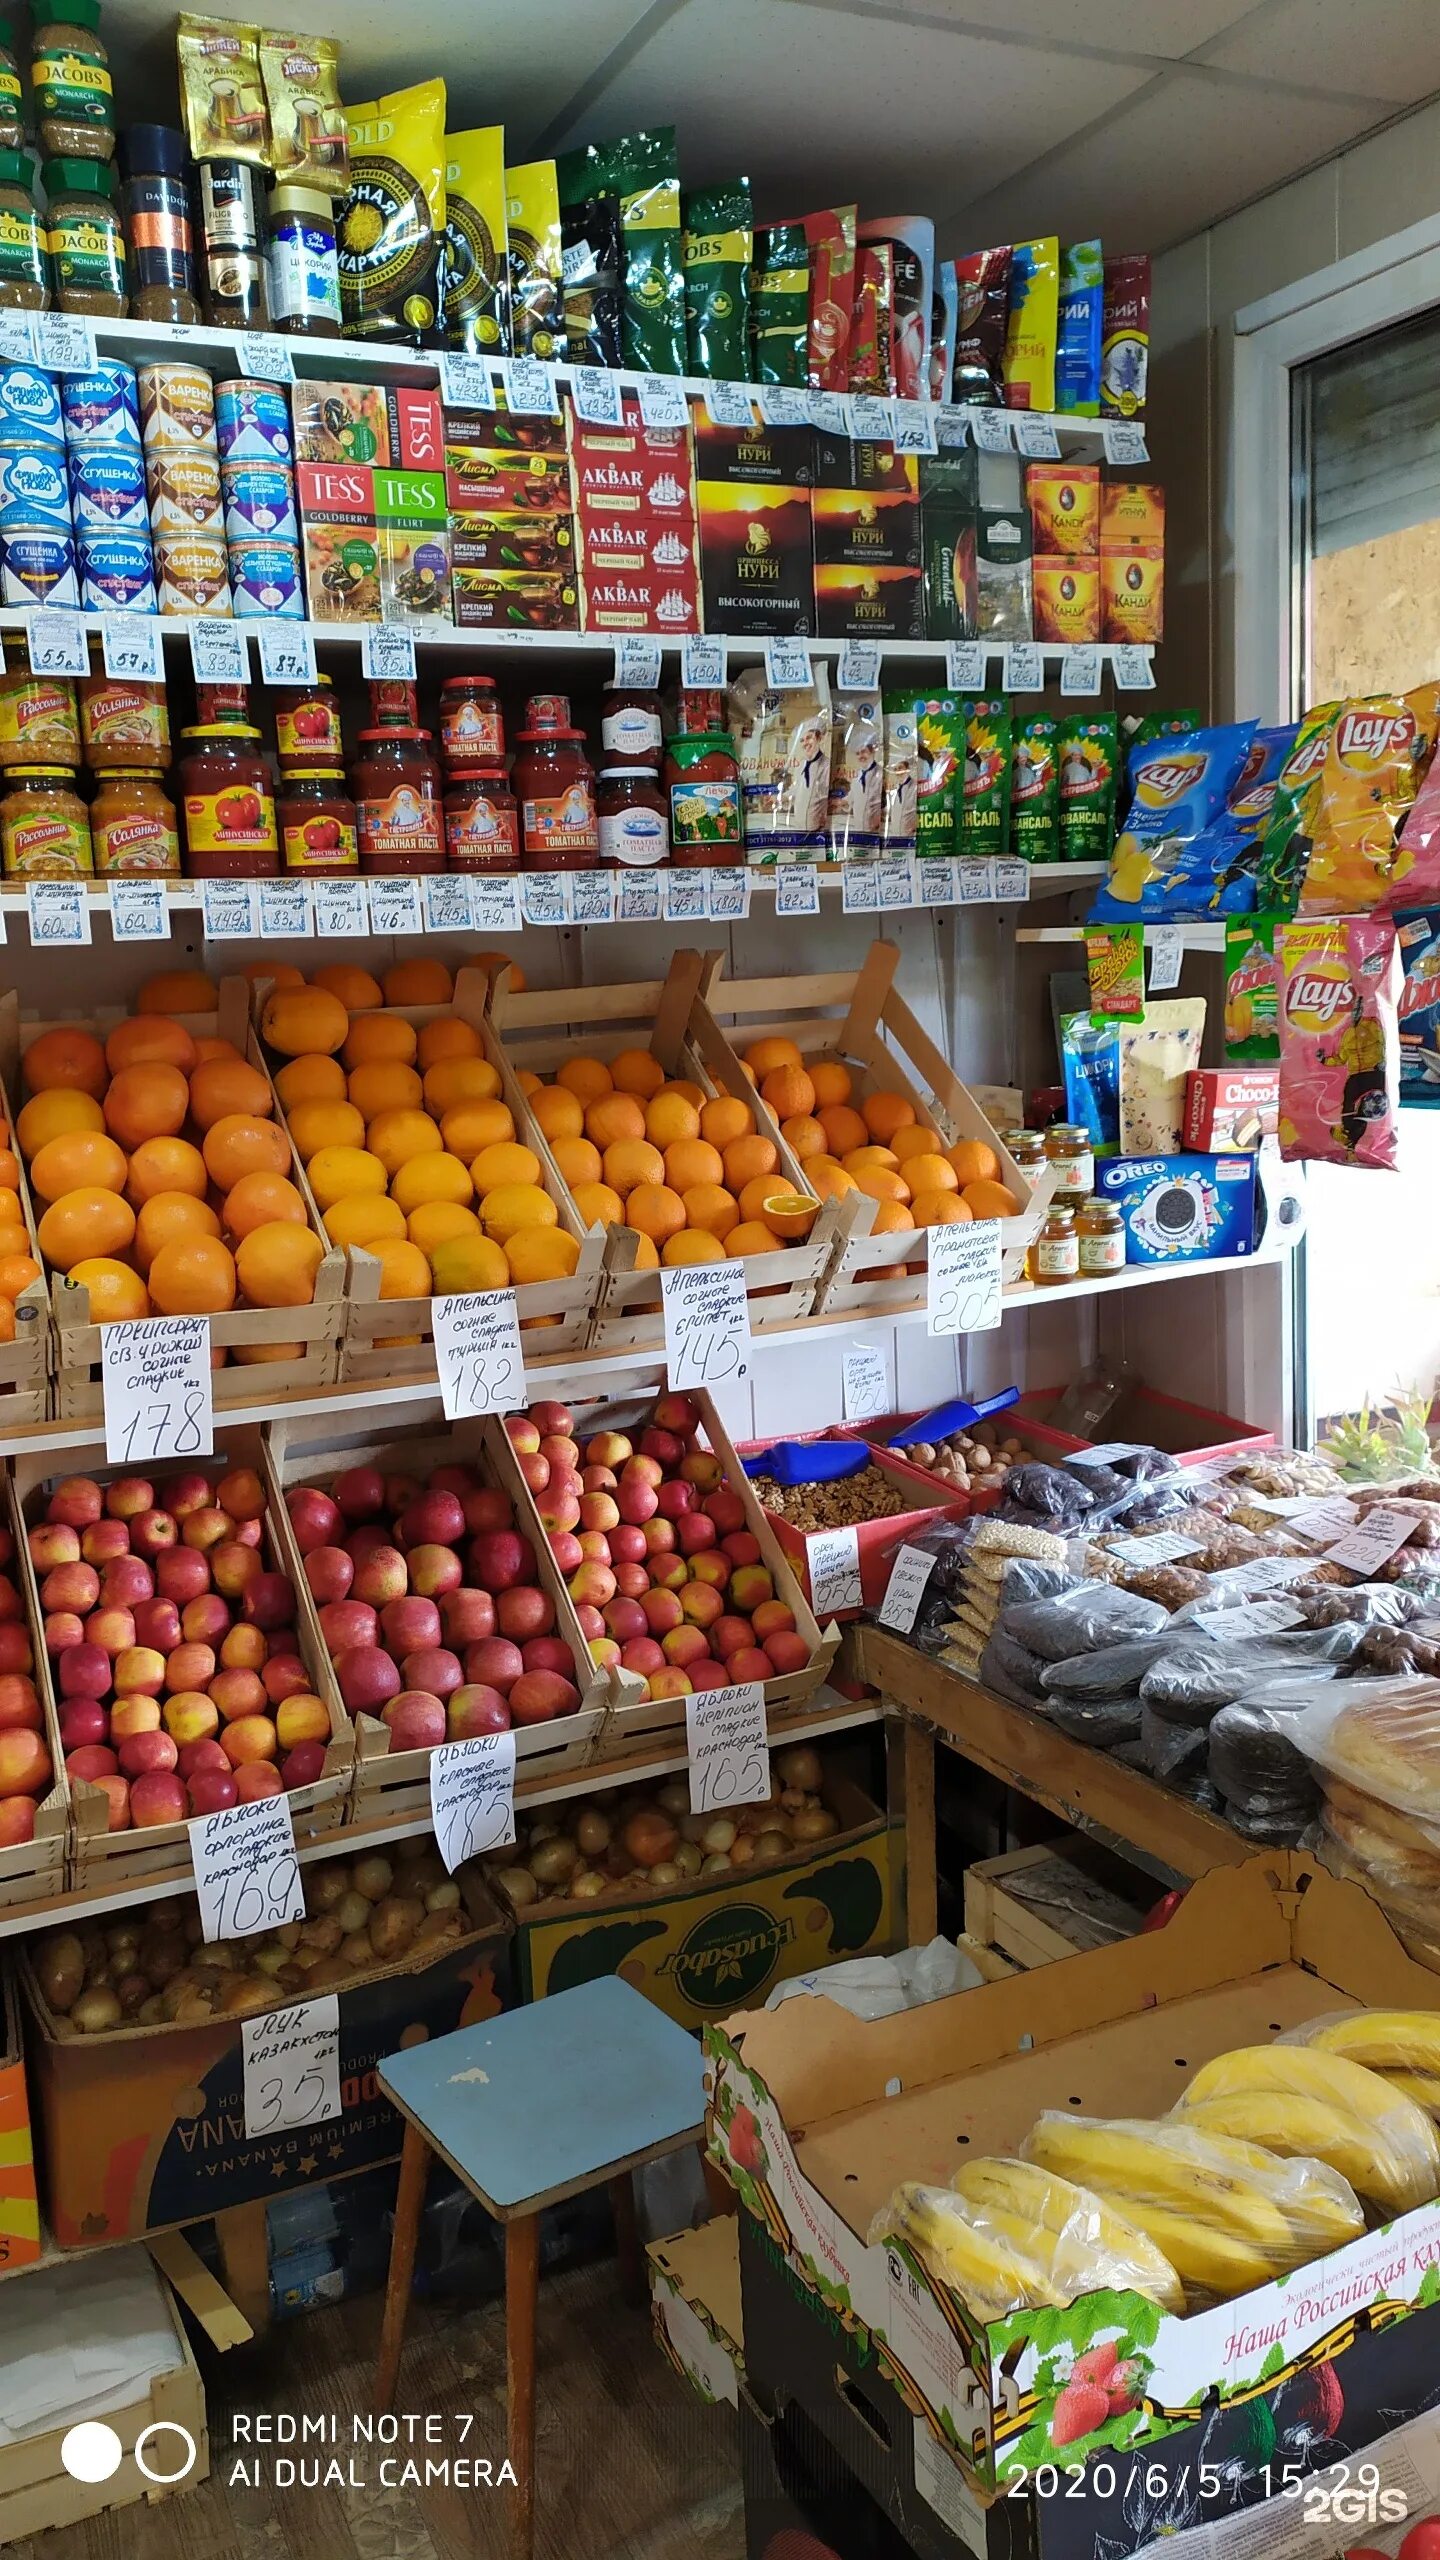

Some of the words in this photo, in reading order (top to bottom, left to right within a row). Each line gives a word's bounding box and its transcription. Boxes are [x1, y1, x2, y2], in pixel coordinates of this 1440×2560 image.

[46, 66, 103, 85] JACOBS
[203, 67, 244, 77] АРАБИКА
[54, 88, 95, 100] MONARCH
[287, 87, 326, 97] ARABICA
[348, 121, 395, 146] OLD
[207, 177, 245, 189] Jardin
[60, 234, 117, 252] JACOBS
[685, 240, 722, 261] OBS
[71, 257, 110, 268] MONARCH
[169, 383, 213, 400] ВАРЕНКА
[387, 395, 400, 460] GOLDBERRY
[407, 401, 436, 460] TESS
[448, 422, 481, 430] КРЕПКИЙ
[900, 429, 924, 447] 152
[737, 449, 772, 462] НУРИ
[83, 468, 138, 482] СГУЩЕНКА
[170, 469, 218, 486] ВАРЕНКА
[582, 468, 643, 487] AKBAR
[309, 473, 365, 504] TESS
[381, 480, 436, 509] TESS
[458, 484, 505, 494] НАСЫЩЕННЫЙ
[309, 511, 369, 525] GOLDBERRY
[397, 519, 424, 528] FLIRT
[588, 527, 648, 545] AKBAR
[852, 531, 884, 544] НУРИ
[16, 546, 59, 558] СГУЩЕНКА
[454, 543, 487, 551] КРЕПКИЙ
[91, 554, 144, 566] СГУЩЕНКА
[172, 554, 221, 567] ВАРЕНКА
[737, 565, 780, 579] НУРИ
[592, 586, 651, 603] AKBAR
[718, 597, 801, 609] ВЫСОКОГОРНЫЙ
[461, 603, 494, 611] КРЕПКИЙ
[854, 604, 886, 618] НУРИ
[91, 697, 140, 719] Солянка
[481, 743, 497, 752] ПАСТА
[917, 812, 954, 828] НСАЛЬ
[18, 824, 67, 845] Рассольник
[109, 823, 160, 845] Солянка
[214, 830, 270, 839] МИНУСИНСКАЯ
[374, 837, 416, 850] ТОМАТНАЯ
[418, 836, 439, 850] ПАСТА
[545, 835, 585, 848] ТОМАТНАЯ
[456, 844, 492, 854] ТОМАТНАЯ
[494, 844, 513, 853] ПАСТА
[1104, 1160, 1168, 1186] OREO
[933, 1286, 999, 1332] 205
[675, 1310, 731, 1335] ЕГИПЕТ
[676, 1329, 743, 1385] 145
[127, 1368, 185, 1393] СЛАДКИЕ
[452, 1358, 517, 1412] 182
[122, 1391, 204, 1463] 178
[817, 1580, 861, 1613] 950
[695, 1685, 752, 1712] ЯБЛОКИ
[712, 1715, 760, 1737] СЛАДКИЕ
[439, 1736, 499, 1768] ЯБЛОКИ
[696, 1732, 763, 1759] КРАСНОДАР
[699, 1754, 763, 1810] 165
[436, 1780, 500, 1815] КРАСНОДАР
[205, 1797, 282, 1838] ЯБЛОКИ
[442, 1793, 510, 1870] 185
[203, 1852, 276, 1887] КРАСНОДАР
[213, 1858, 297, 1940] 169
[655, 1917, 797, 1978] Ecuasabor
[253, 2008, 310, 2040] ЛУК
[251, 2067, 324, 2133] 35
[205, 2140, 298, 2176] BANANA
[1358, 2242, 1400, 2271] чистый
[1402, 2220, 1440, 2249] продук
[1223, 2317, 1288, 2366] Наша
[1293, 2256, 1407, 2330] Российская
